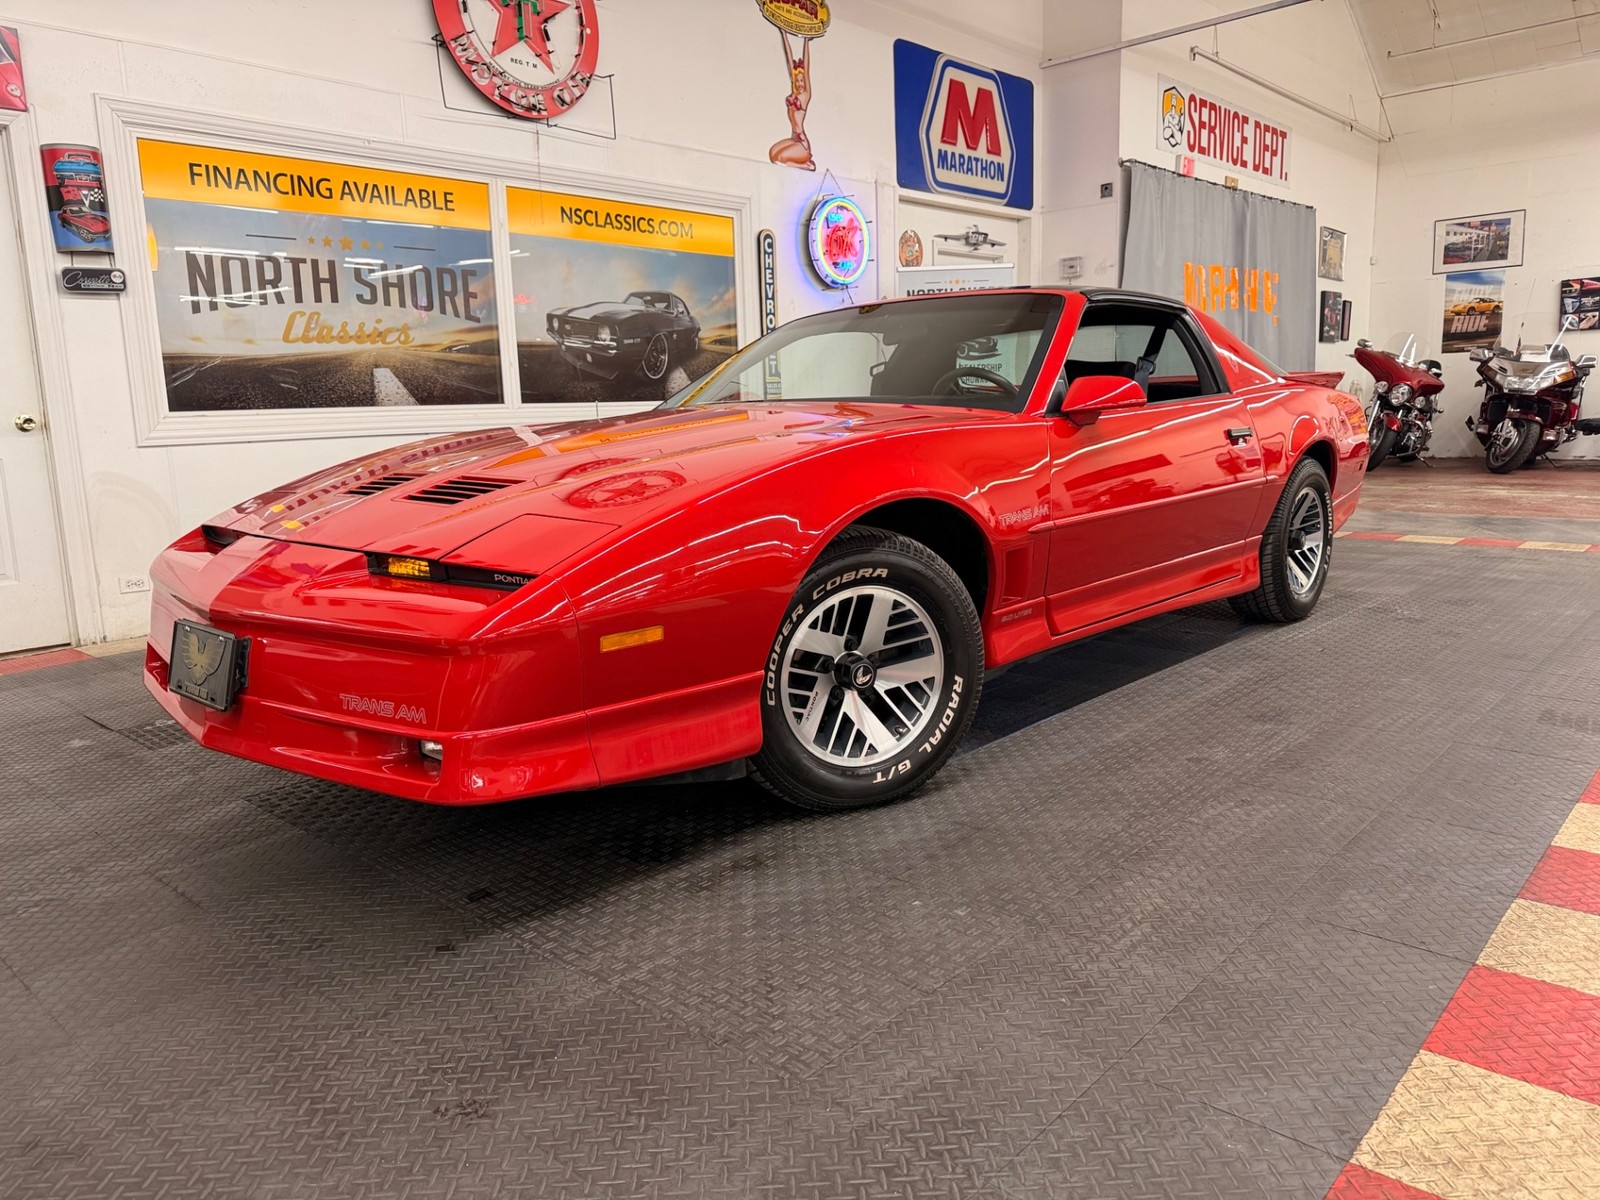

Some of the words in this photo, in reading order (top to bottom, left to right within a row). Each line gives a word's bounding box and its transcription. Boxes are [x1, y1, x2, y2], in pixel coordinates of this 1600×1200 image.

[1186, 93, 1250, 169] SERVICE
[1252, 119, 1288, 182] DEPT.
[937, 147, 1005, 183] MARATHON
[188, 162, 334, 200] FINANCING
[339, 180, 456, 213] AVAILABLE
[559, 205, 695, 240] NSCLASSICS.COM
[184, 249, 340, 315] NORTH
[353, 260, 482, 324] SHORE
[281, 310, 416, 346] Classics
[1450, 314, 1490, 334] RIDE
[1000, 507, 1033, 527] TRANS
[812, 567, 889, 601] COBRA
[765, 603, 805, 706] COOPER
[339, 693, 395, 717] TRANS
[395, 703, 427, 724] AM
[918, 674, 964, 754] RADIAL
[871, 758, 913, 785] G/T
